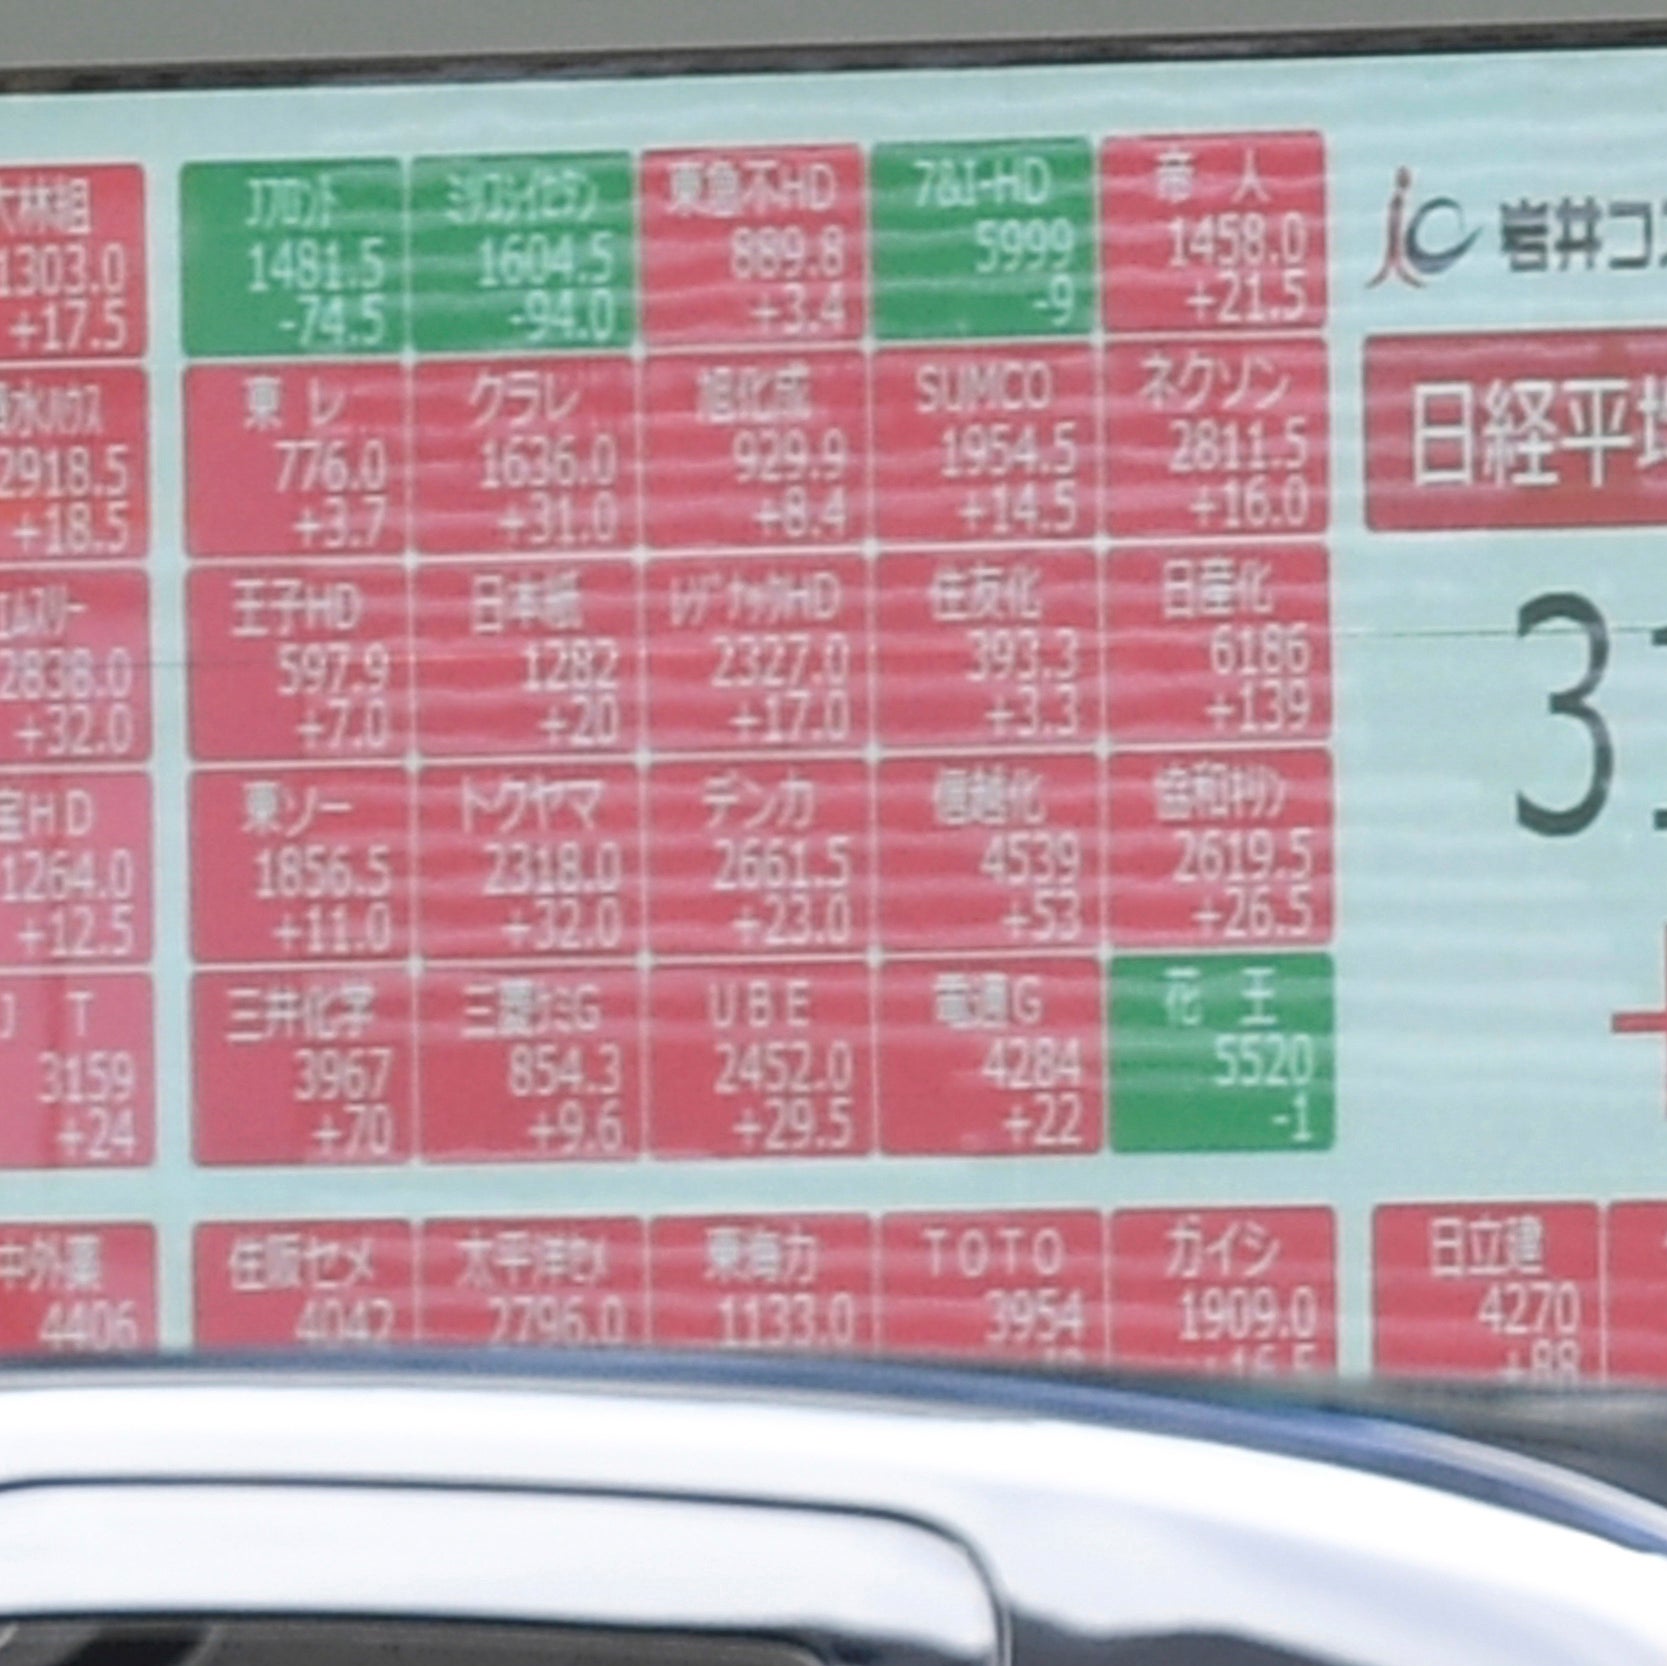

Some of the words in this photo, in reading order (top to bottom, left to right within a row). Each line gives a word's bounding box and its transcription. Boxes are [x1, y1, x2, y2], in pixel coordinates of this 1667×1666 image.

[248, 238, 384, 291] 1481.5
[974, 219, 1075, 274] 5999
[278, 295, 384, 346] -74.5
[1033, 280, 1075, 326] -9
[470, 371, 580, 427] クラレ
[915, 361, 1052, 415] SUMCO
[1140, 354, 1292, 409] ネクソン
[275, 440, 387, 492] 776.0
[480, 436, 616, 489] 1636.0
[941, 424, 1077, 477] 1954.5
[1168, 418, 1308, 474] 2811.5
[294, 496, 386, 546] +3.7
[959, 478, 1077, 531] +14.5
[232, 578, 361, 637] 王子HD
[277, 643, 389, 696] 597.9
[296, 700, 389, 749] +7.0
[256, 847, 391, 898] 1856.5
[273, 904, 392, 952] +11.0
[709, 978, 811, 1030] UBE
[37, 1050, 135, 1103] 3159
[294, 1048, 393, 1099] 3967
[508, 1044, 621, 1097] 854.3
[982, 1038, 1082, 1091] 4284
[1215, 1035, 1314, 1087] 5520
[56, 1110, 135, 1161] +24
[312, 1105, 393, 1155] +70
[530, 1102, 621, 1152] +9.6
[732, 1098, 853, 1151] +29.5
[1004, 1094, 1082, 1147] +22
[1272, 1093, 1313, 1144] -1
[924, 1227, 1065, 1278] TOTO
[1164, 1212, 1281, 1279] ガイシ
[1178, 1287, 1317, 1342] 1909.0
[1478, 1280, 1581, 1332] 4270
